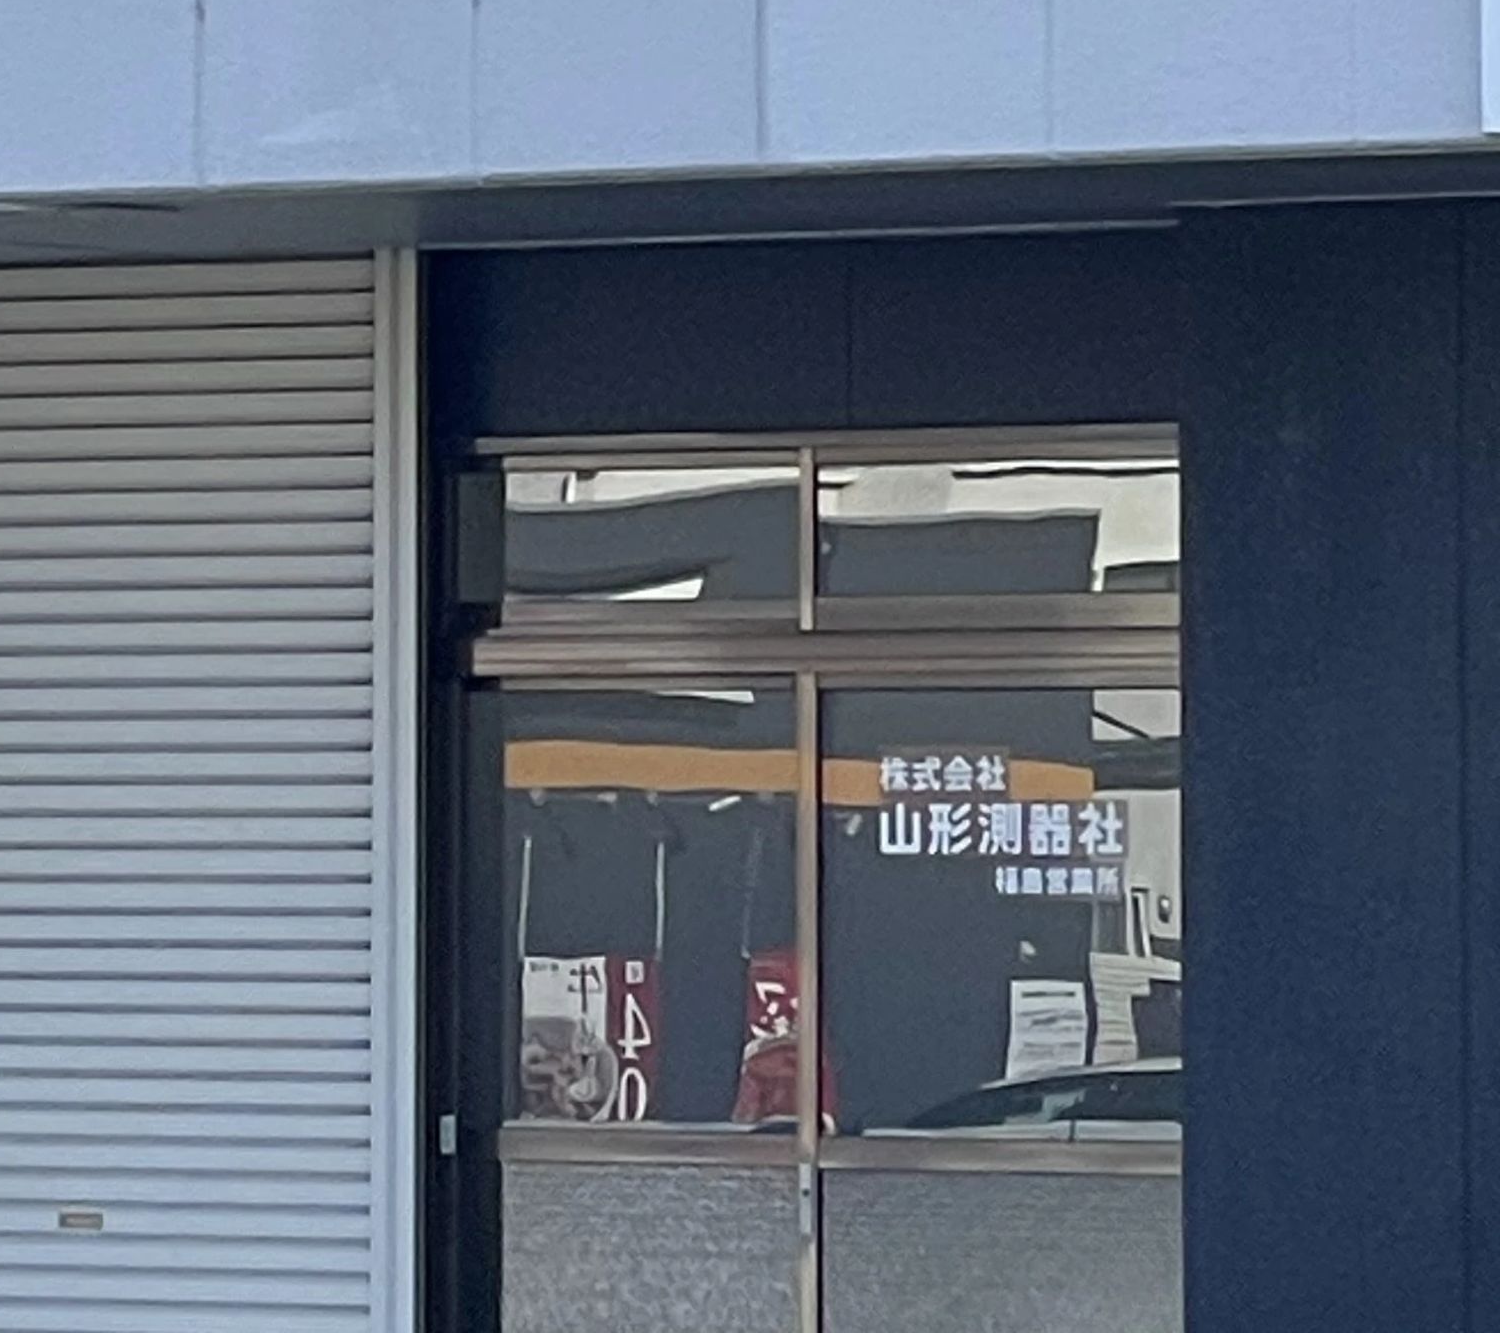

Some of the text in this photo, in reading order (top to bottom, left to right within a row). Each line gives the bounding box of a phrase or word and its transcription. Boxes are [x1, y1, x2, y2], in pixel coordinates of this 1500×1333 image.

[878, 754, 1007, 792] 株式会社
[878, 801, 1124, 857] 山形測器社
